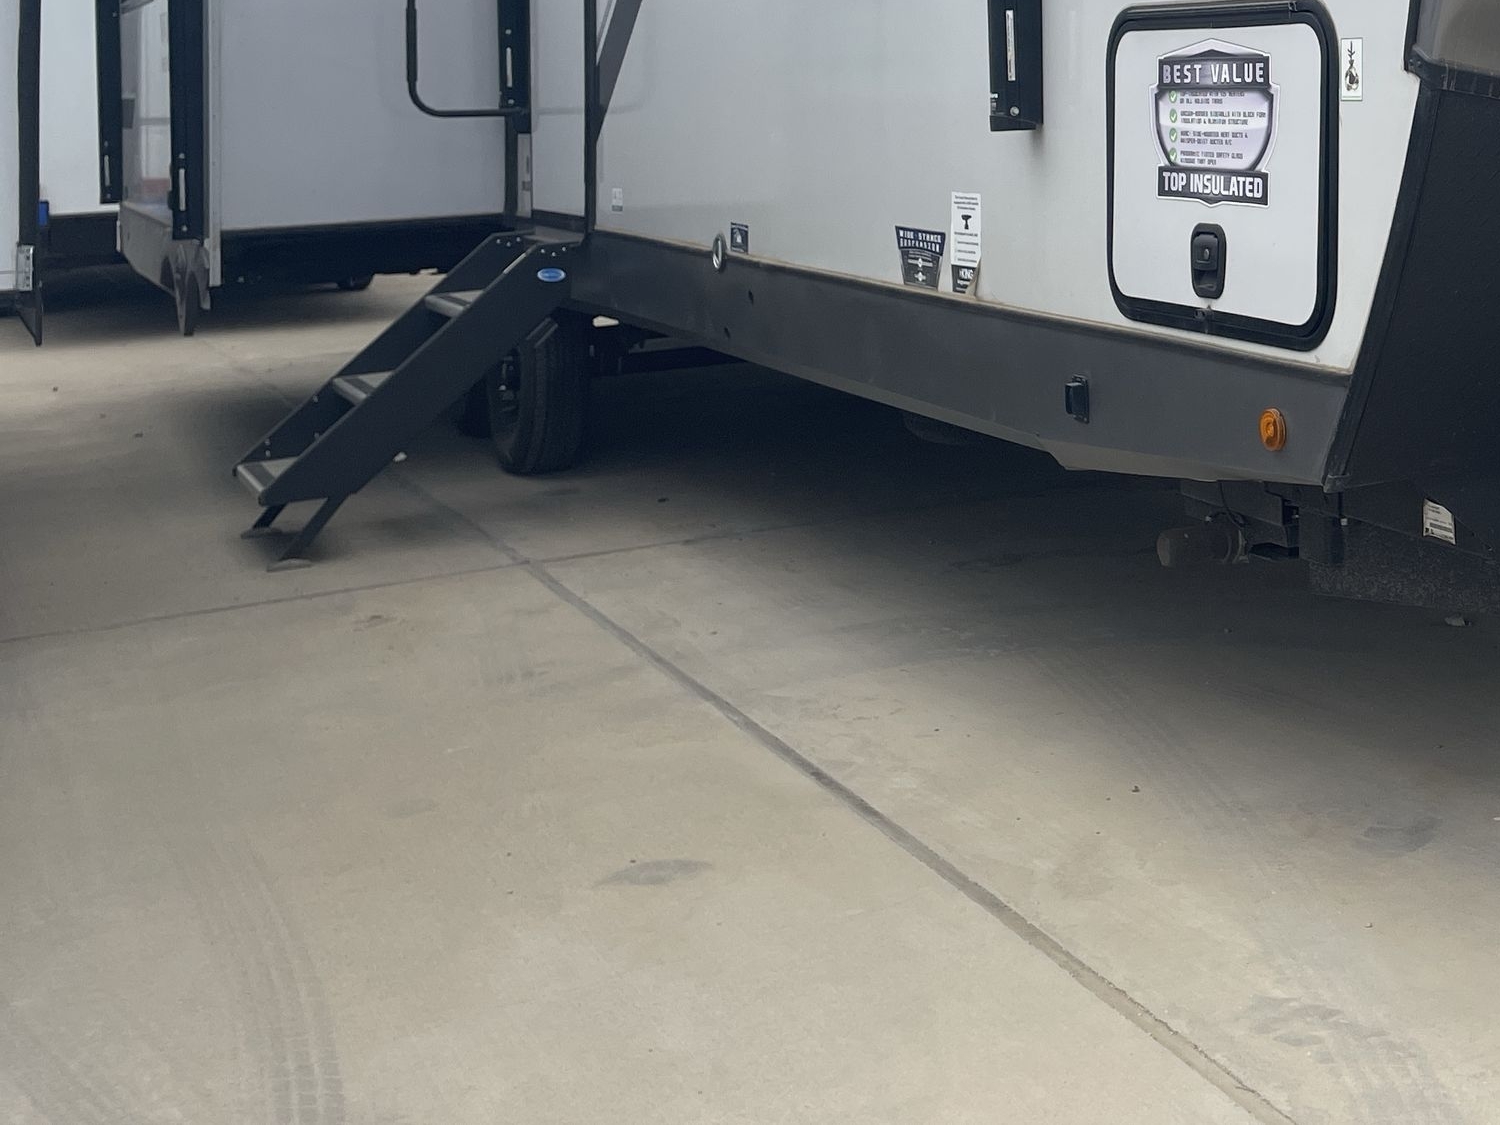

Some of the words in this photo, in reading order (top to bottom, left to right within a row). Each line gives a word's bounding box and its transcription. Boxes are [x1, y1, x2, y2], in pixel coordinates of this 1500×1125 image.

[1162, 64, 1202, 84] BEST
[1210, 62, 1264, 83] VALUE
[1163, 172, 1187, 192] TOP
[1190, 173, 1263, 198] INSULATED
